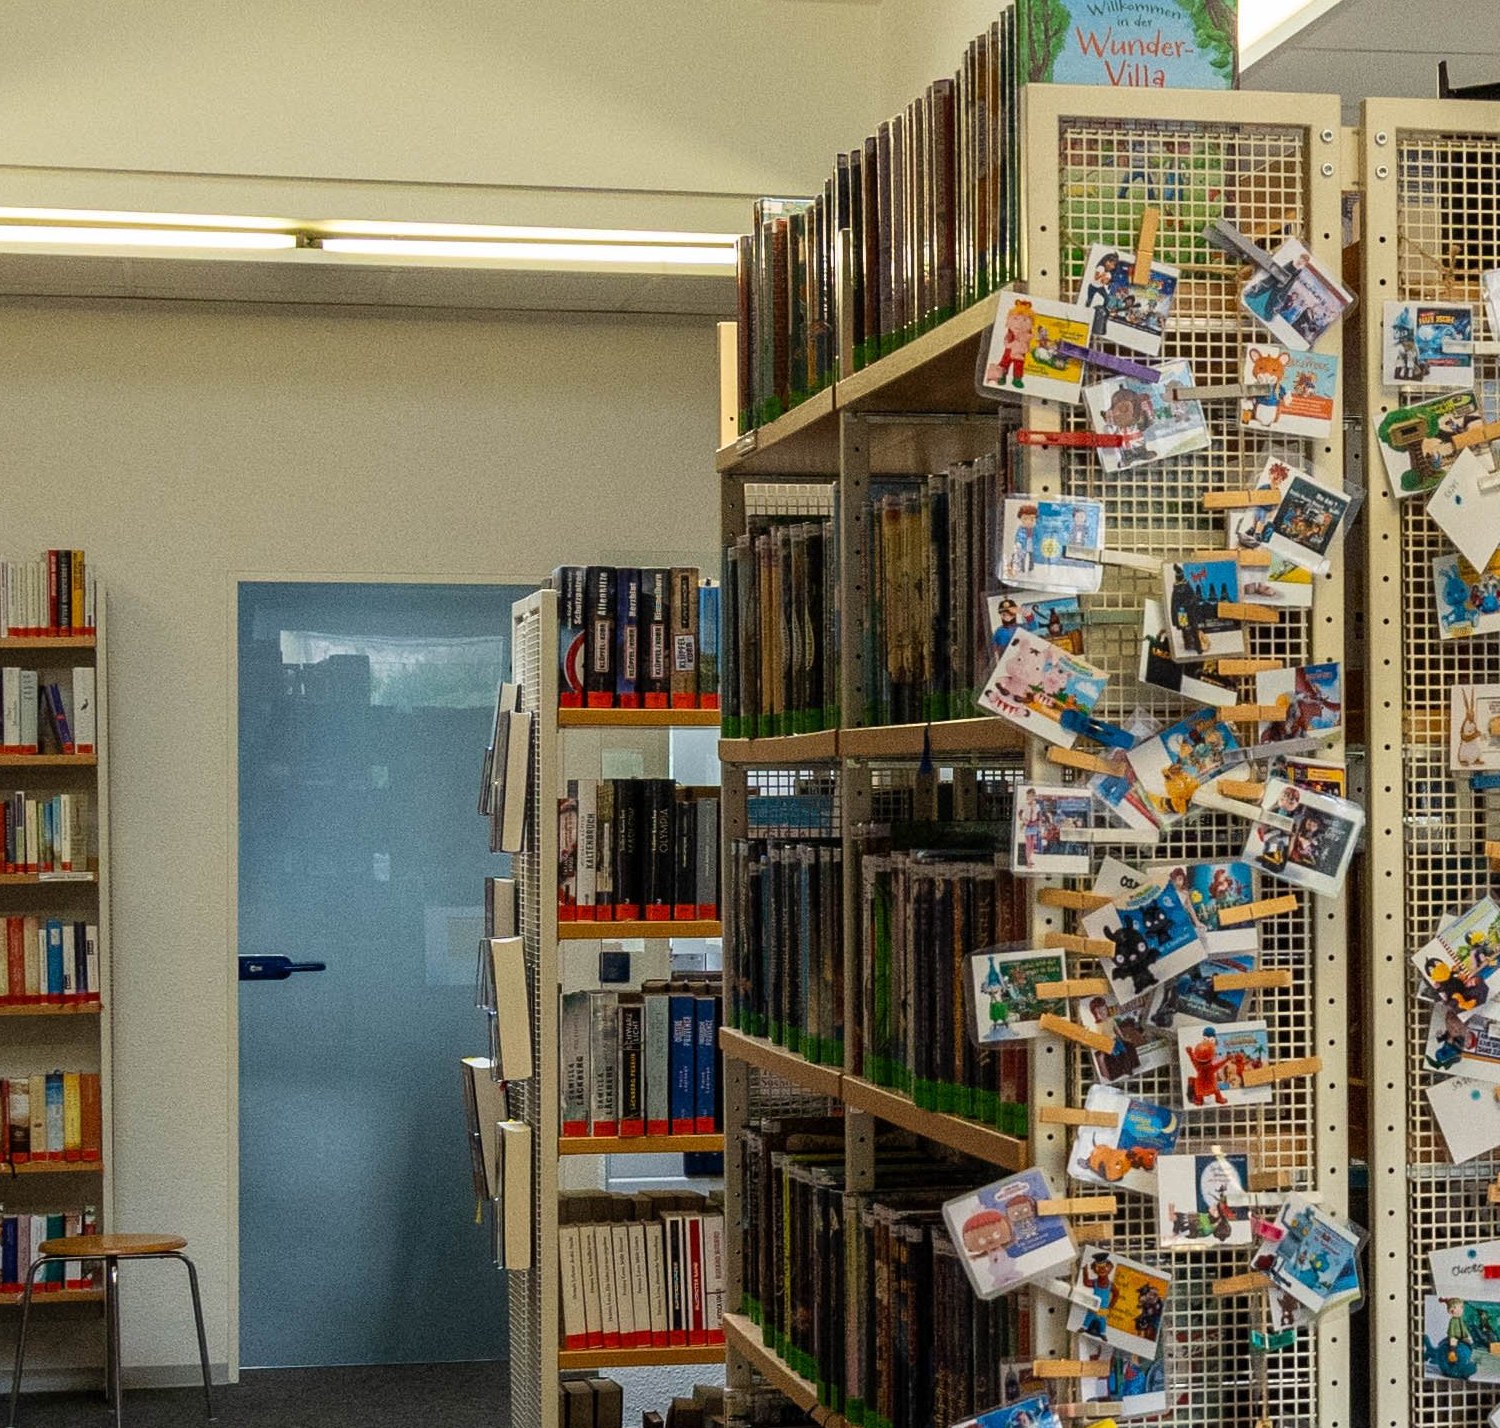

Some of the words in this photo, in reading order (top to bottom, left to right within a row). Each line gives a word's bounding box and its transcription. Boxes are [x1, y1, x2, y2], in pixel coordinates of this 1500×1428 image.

[1086, 0, 1181, 24] Willkommen
[1117, 17, 1129, 29] in
[1134, 14, 1152, 28] der
[1076, 28, 1193, 61] Wunder-
[1104, 58, 1166, 88] Villa
